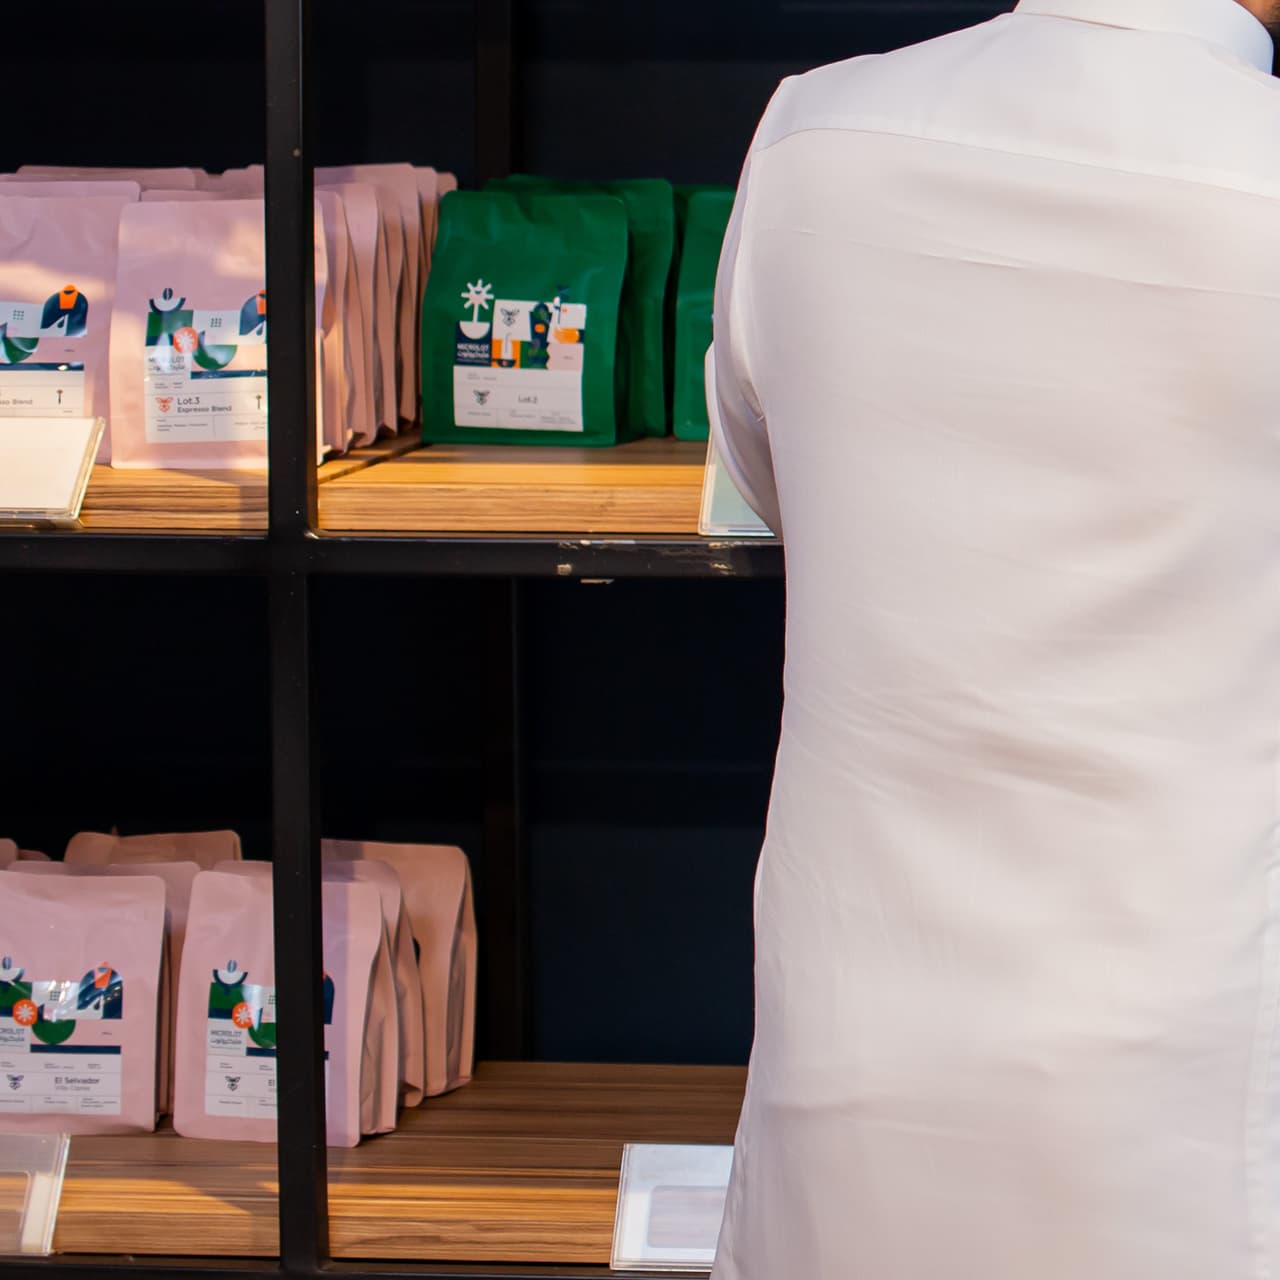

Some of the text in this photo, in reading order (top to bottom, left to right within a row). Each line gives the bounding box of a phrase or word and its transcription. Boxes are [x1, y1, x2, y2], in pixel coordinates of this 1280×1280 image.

[177, 396, 200, 406] Lot.3
[177, 405, 232, 414] Espresso Blend
[54, 1076, 63, 1084] El
